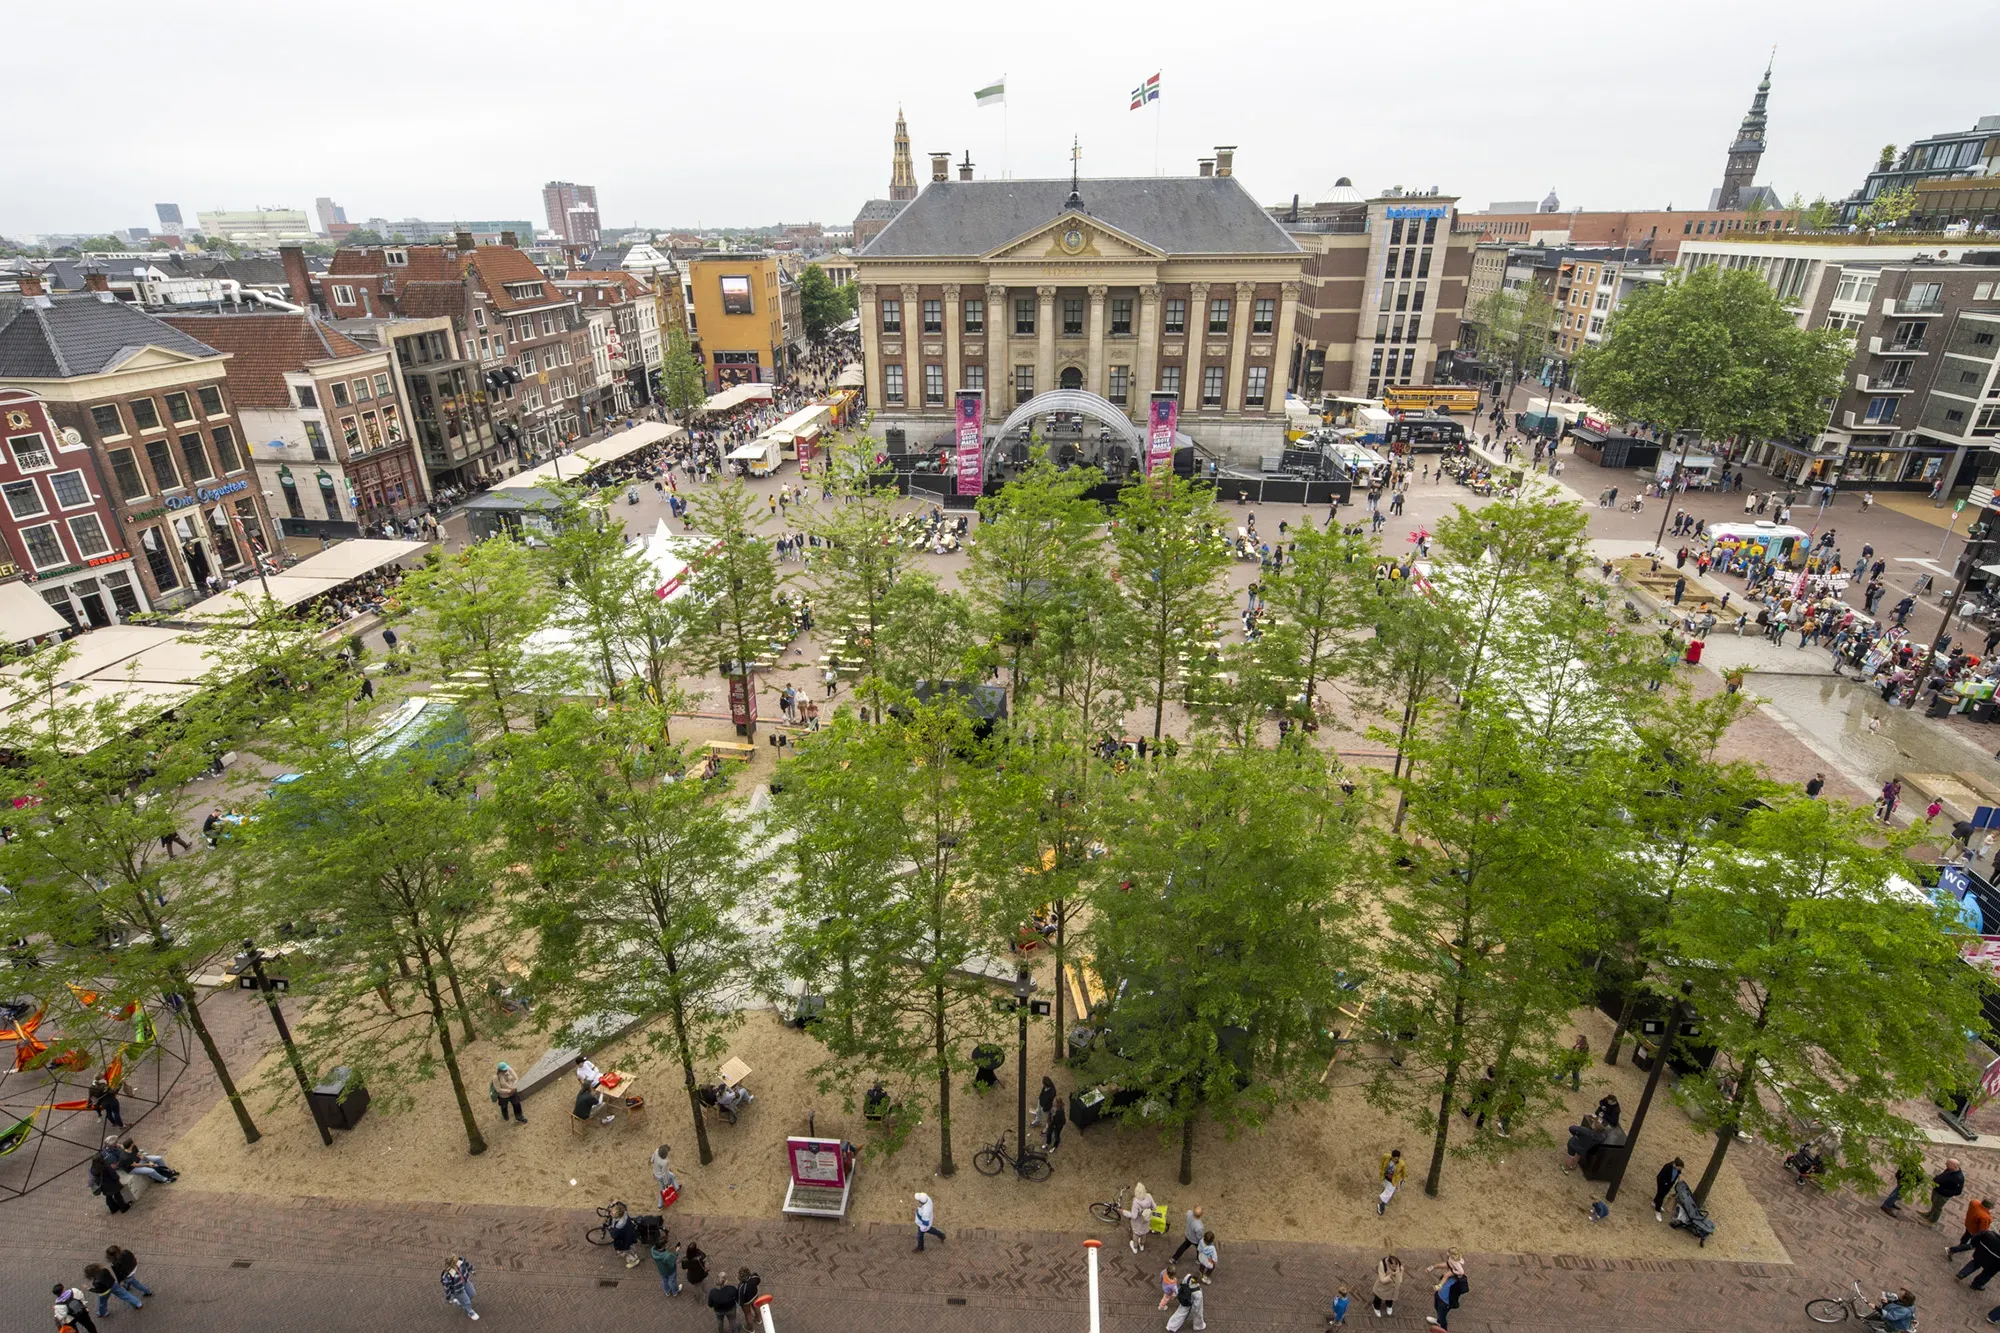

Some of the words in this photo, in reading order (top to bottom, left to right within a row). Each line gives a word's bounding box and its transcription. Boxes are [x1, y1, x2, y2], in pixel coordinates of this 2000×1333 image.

[1386, 204, 1446, 222] belsimpel
[164, 495, 196, 509] Drie
[197, 480, 248, 504] Gezusters
[1944, 869, 1966, 891] WC
